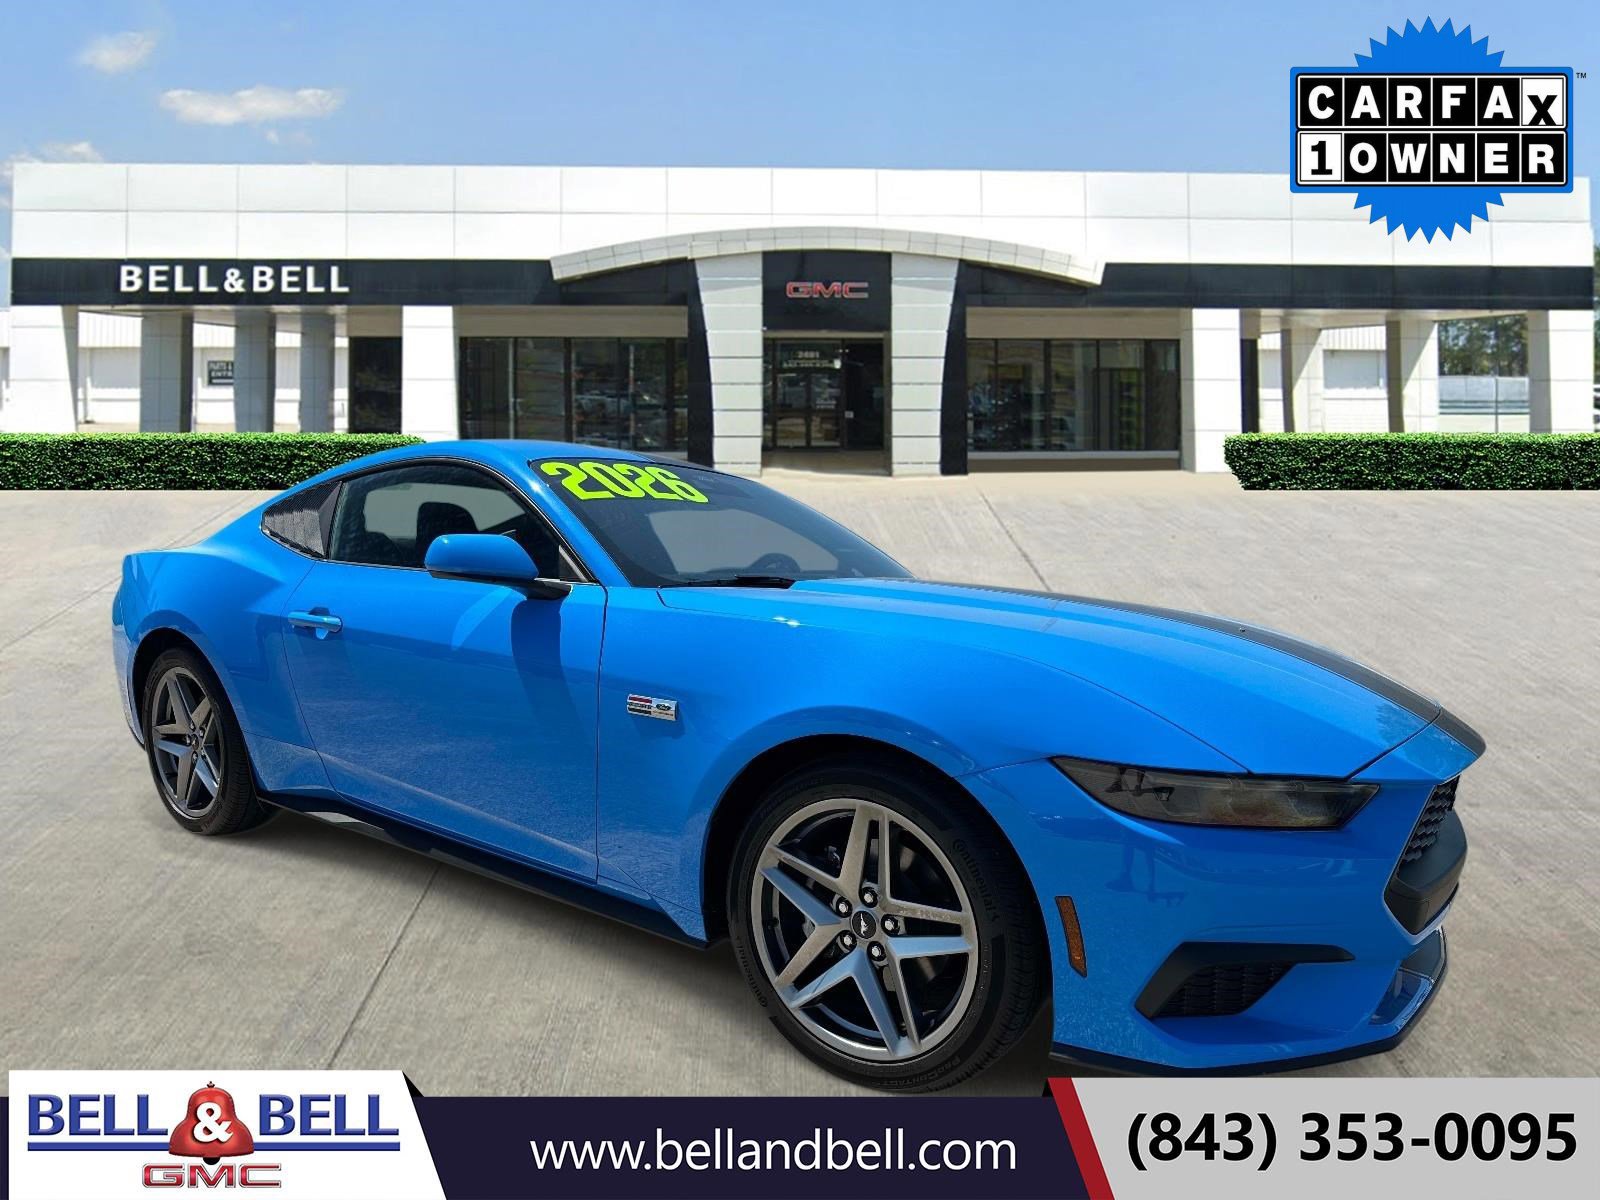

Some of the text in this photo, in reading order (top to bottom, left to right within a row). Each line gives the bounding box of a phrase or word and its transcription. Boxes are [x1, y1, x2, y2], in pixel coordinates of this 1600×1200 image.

[786, 281, 869, 298] GMC
[540, 462, 708, 502] 2026
[953, 839, 997, 911] Continental
